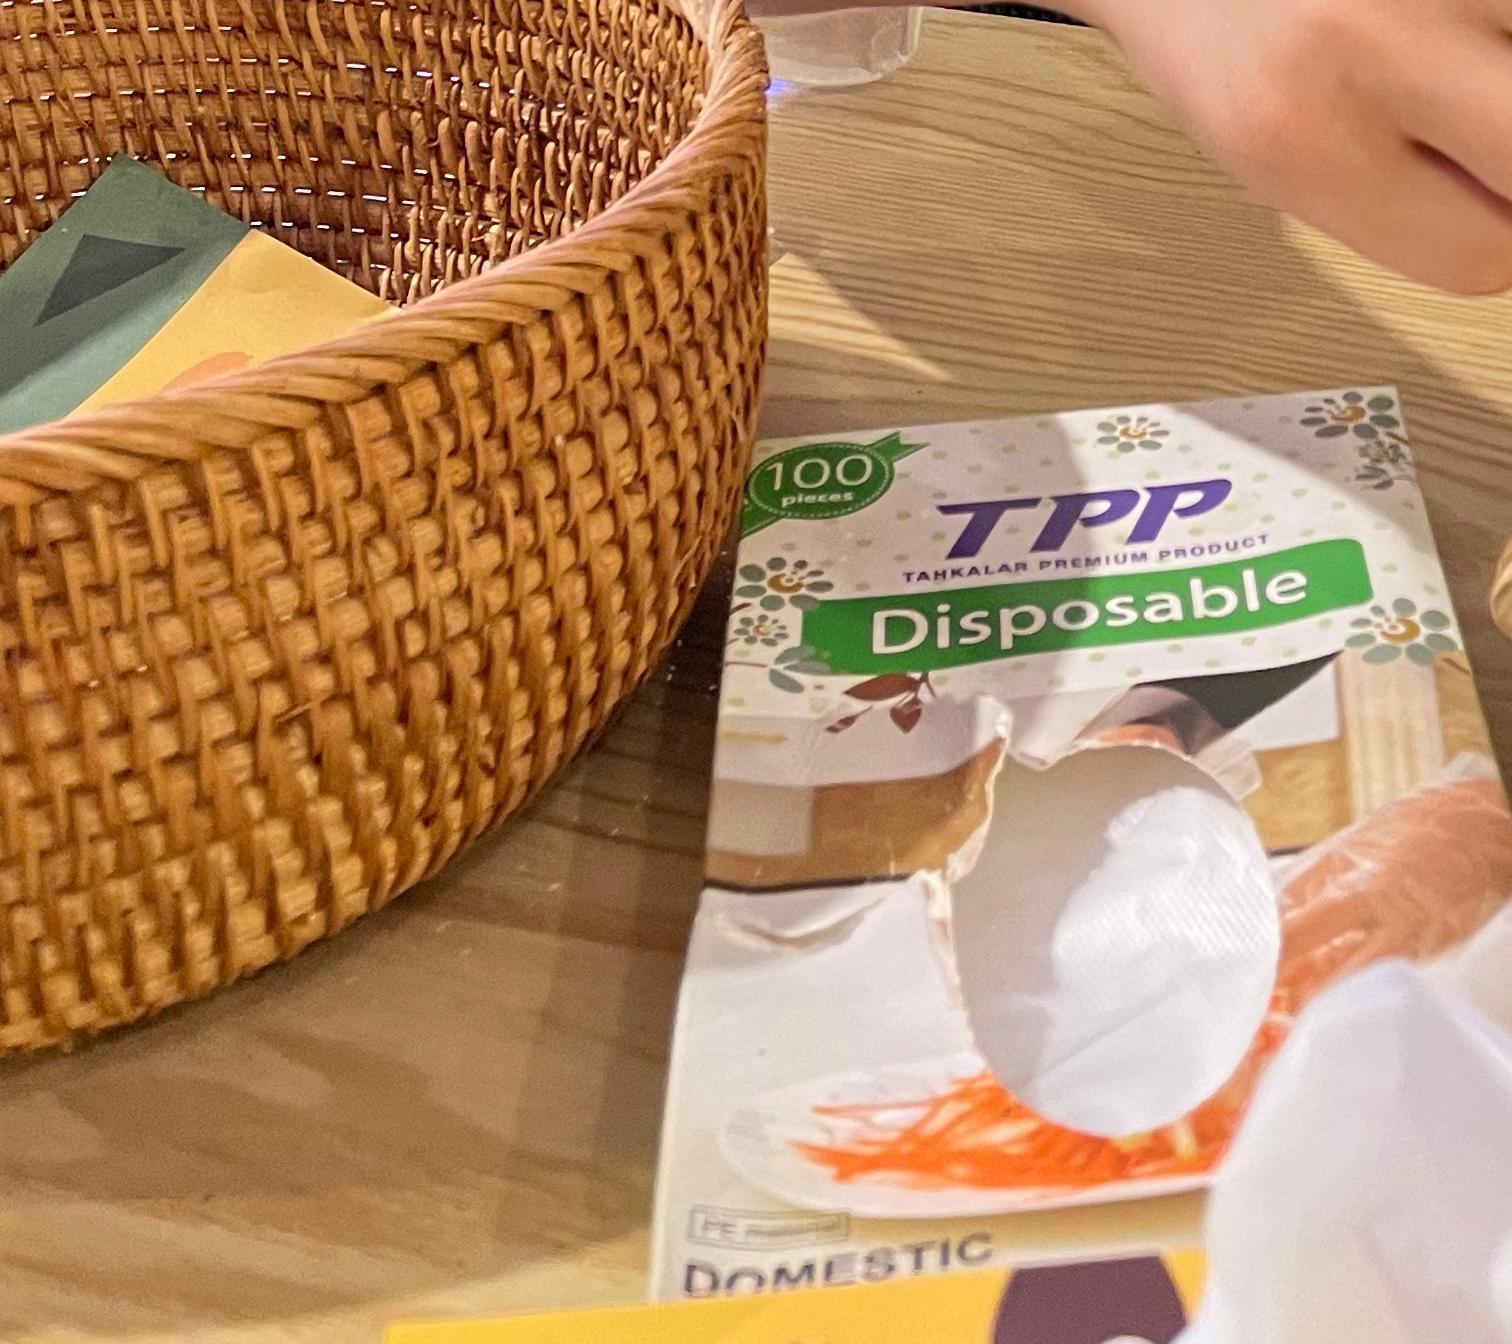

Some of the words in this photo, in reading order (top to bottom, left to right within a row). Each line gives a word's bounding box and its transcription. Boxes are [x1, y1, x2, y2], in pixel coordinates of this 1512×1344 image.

[766, 454, 873, 491] 100
[781, 492, 854, 508] pieces
[936, 478, 1233, 560] TPP
[903, 562, 1028, 584] TAHKALAR
[1039, 551, 1148, 571] PREMIUM
[1158, 533, 1270, 560] PRODUCT
[872, 568, 1307, 654] Disposable
[684, 1230, 993, 1298] DOMESTIC
